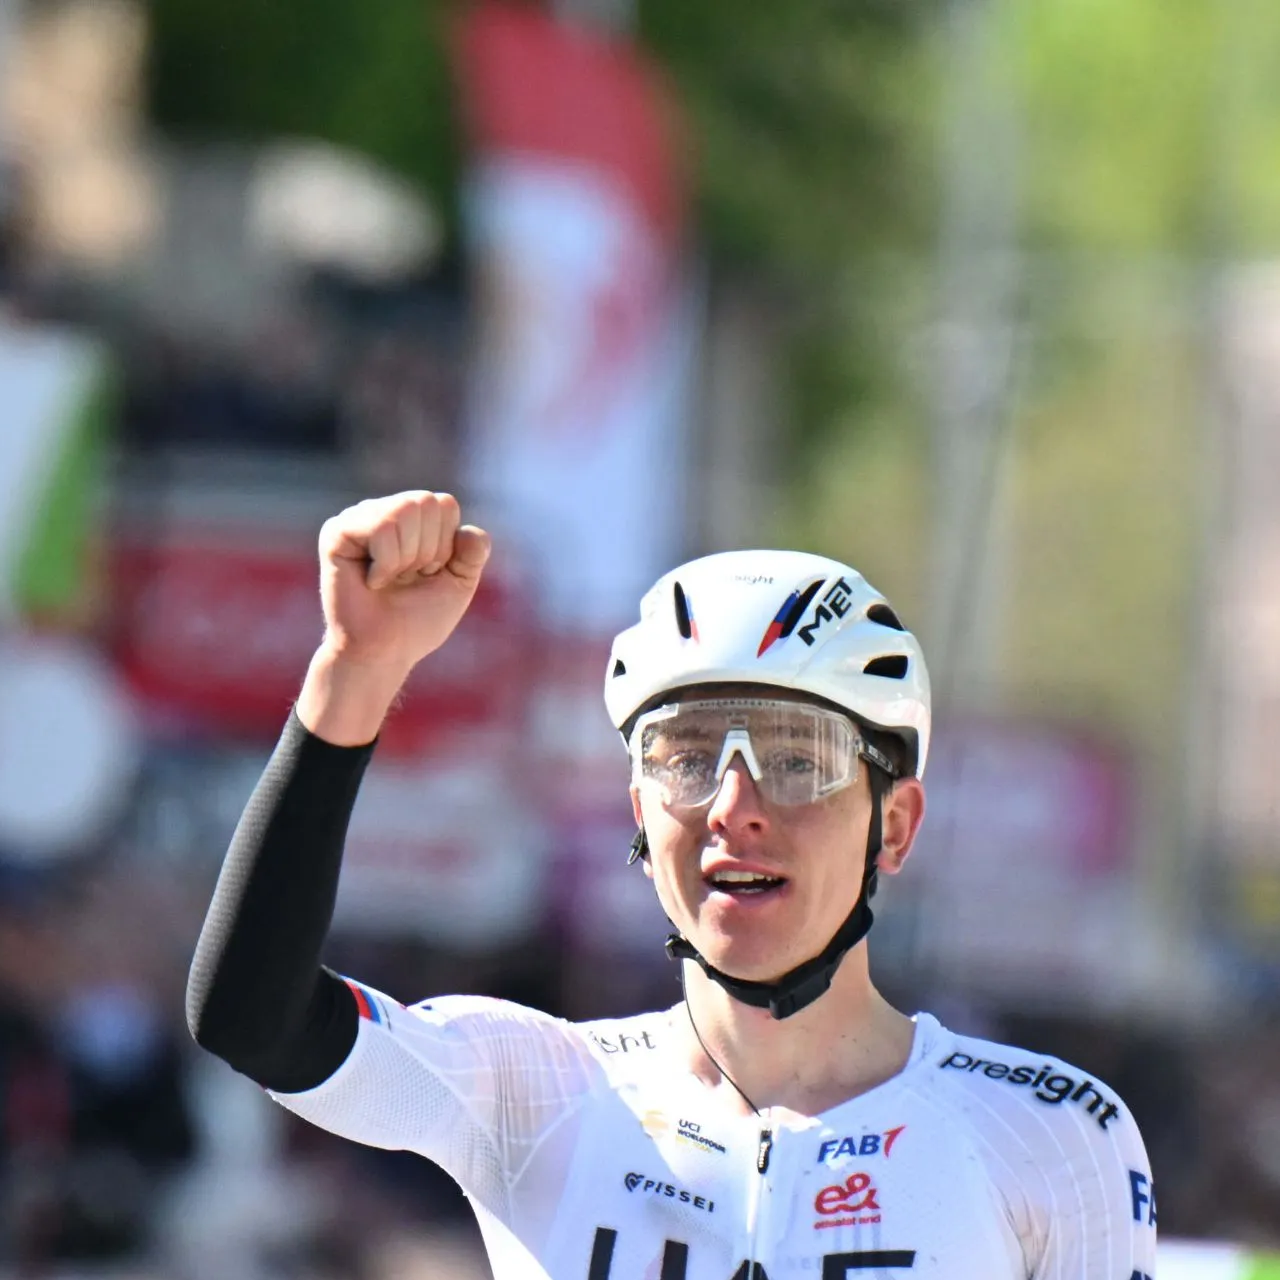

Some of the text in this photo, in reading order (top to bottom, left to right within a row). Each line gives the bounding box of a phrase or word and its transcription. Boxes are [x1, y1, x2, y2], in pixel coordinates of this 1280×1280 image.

[796, 576, 853, 647] MET
[939, 1051, 1119, 1130] presight
[678, 1118, 701, 1133] UCI
[643, 1179, 714, 1213] PISSEI
